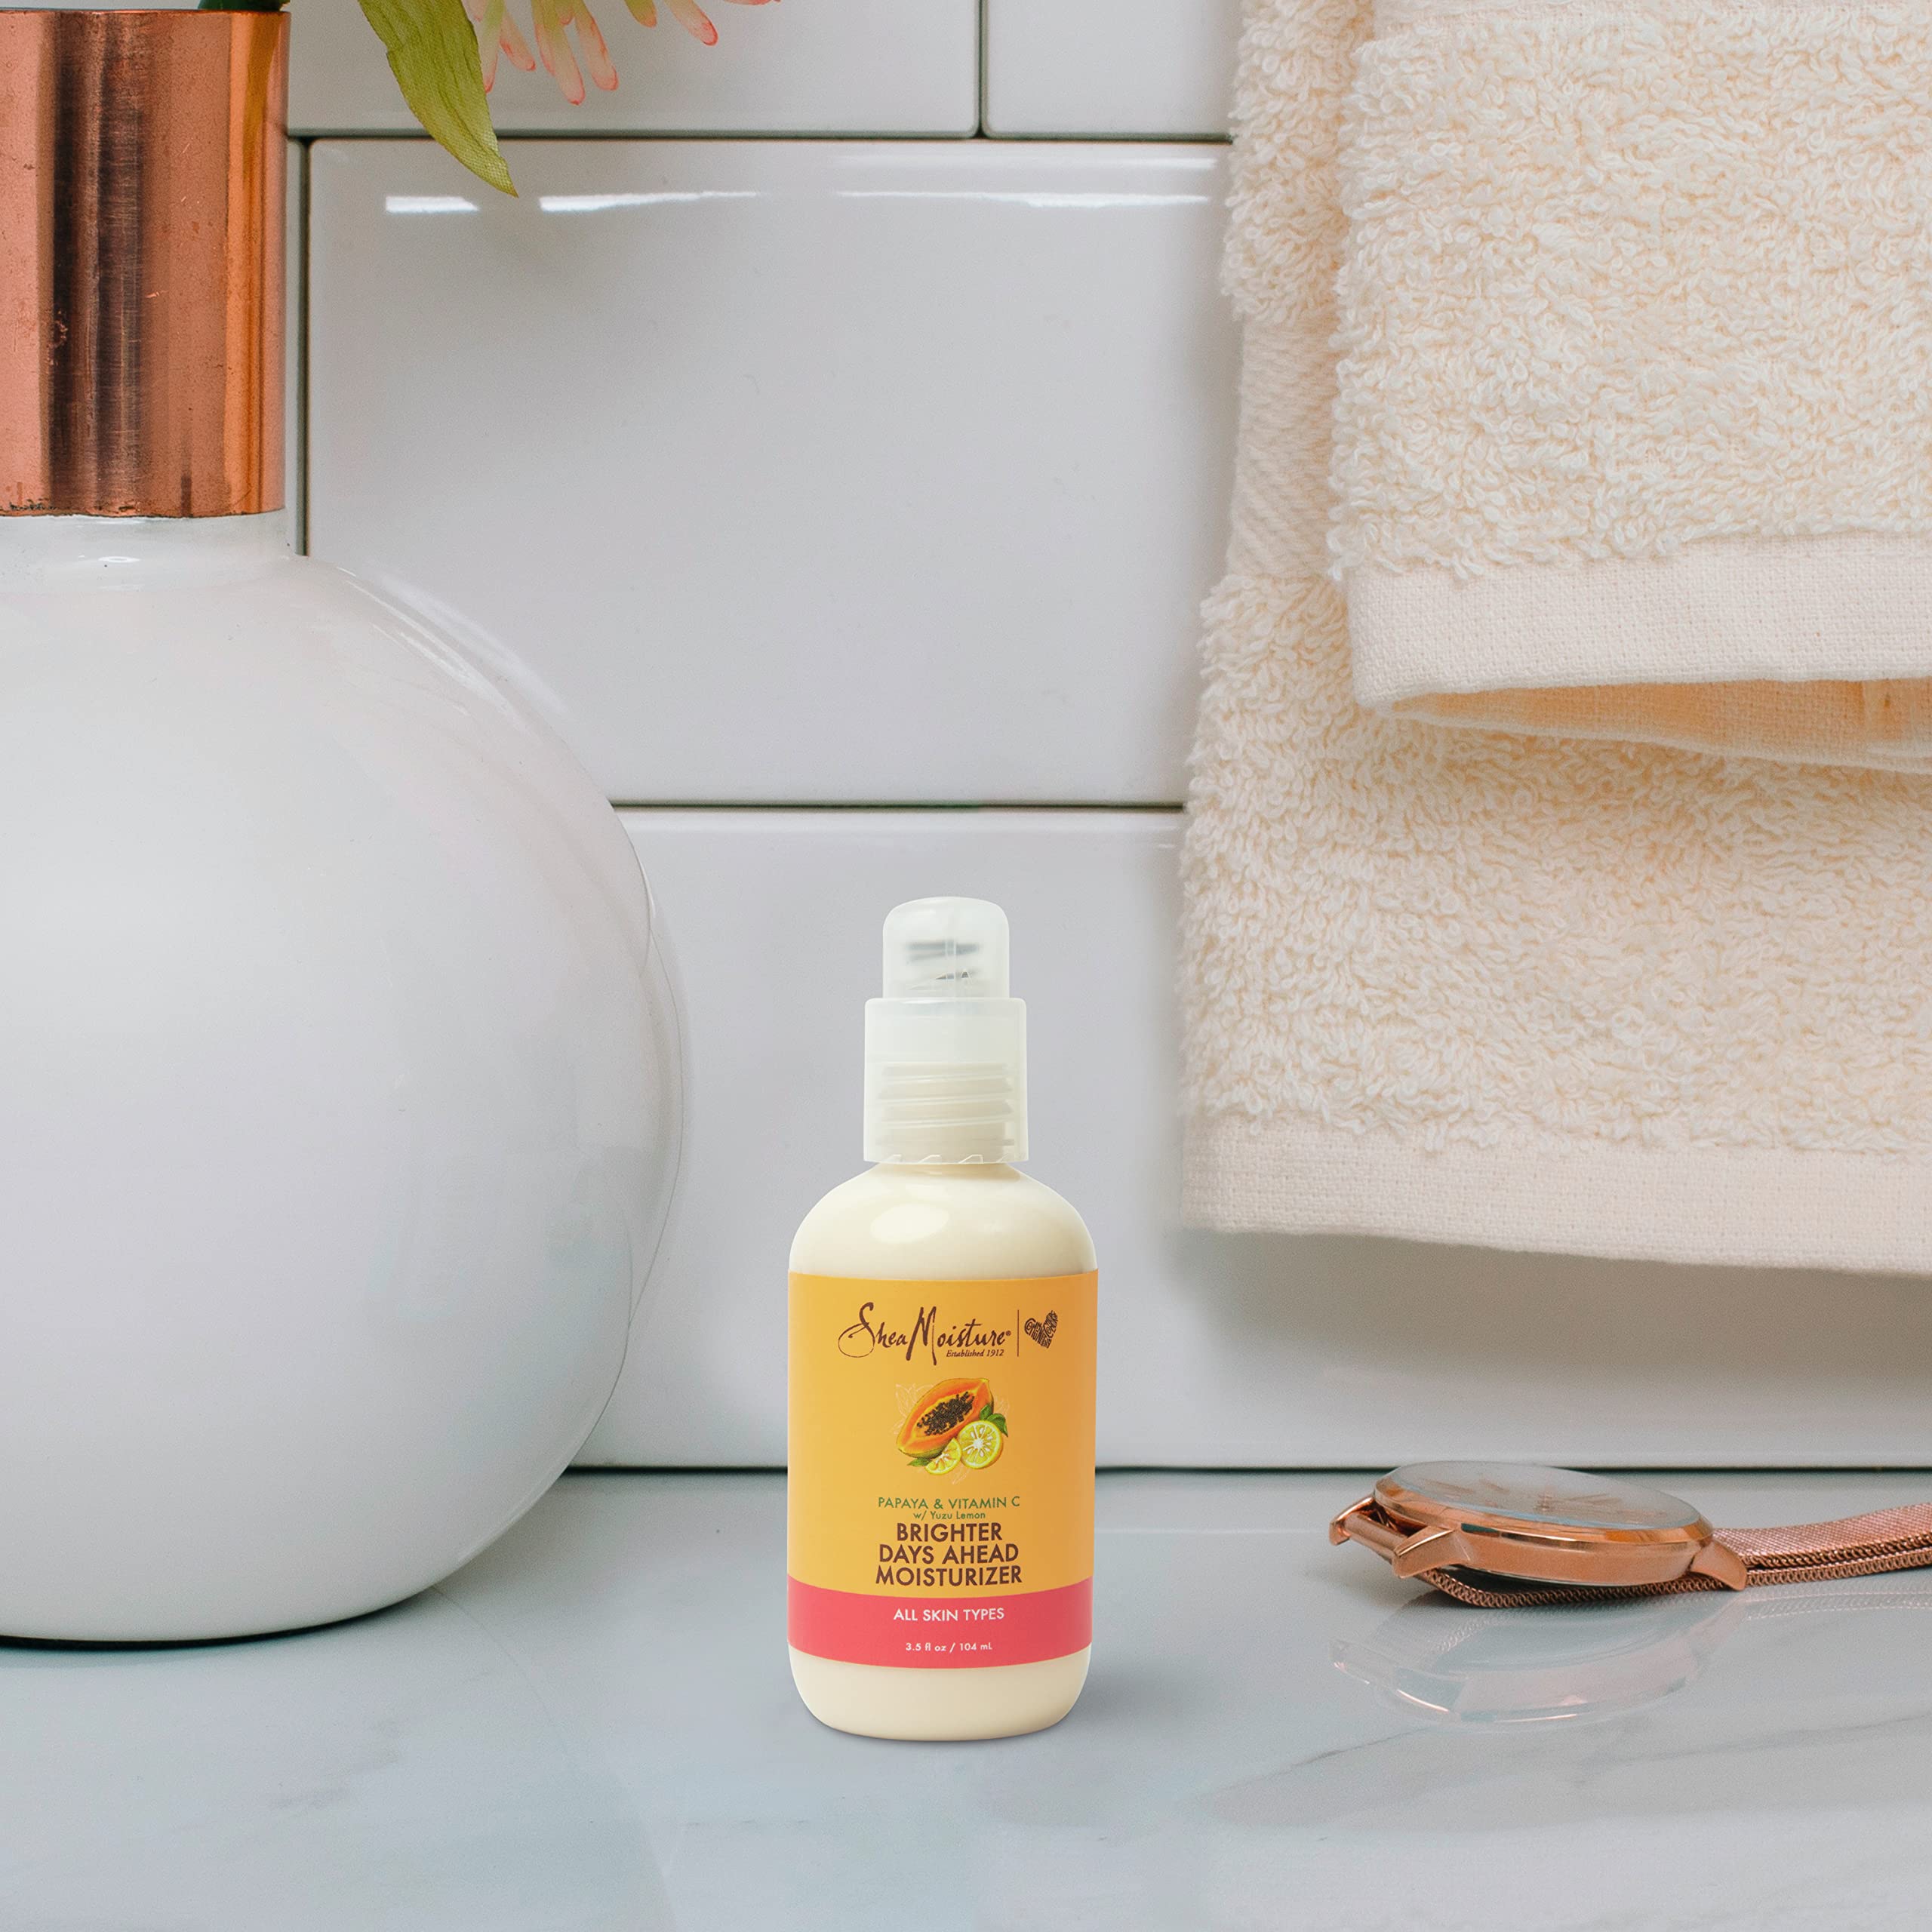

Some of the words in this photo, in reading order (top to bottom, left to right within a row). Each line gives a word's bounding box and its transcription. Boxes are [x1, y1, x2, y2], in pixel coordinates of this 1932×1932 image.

[878, 1497, 929, 1509] PAPAYA
[933, 1498, 944, 1509] &
[948, 1497, 1007, 1509] VITAMIN
[1011, 1496, 1020, 1506] C
[913, 1511, 927, 1521] w/
[930, 1511, 952, 1520] Yuzu
[956, 1511, 986, 1520] Lemon
[897, 1522, 1003, 1543] BRIGHTER
[879, 1544, 934, 1564] DAYS
[942, 1543, 1019, 1564] AHEAD
[875, 1564, 1023, 1587] MOISTURIZER
[893, 1608, 918, 1621] ALL
[922, 1609, 958, 1622] SKIN
[962, 1607, 1004, 1621] TYPES
[905, 1642, 921, 1651] 3.5
[924, 1642, 931, 1651] fl
[959, 1642, 977, 1651] 104
[980, 1641, 992, 1651] mL
